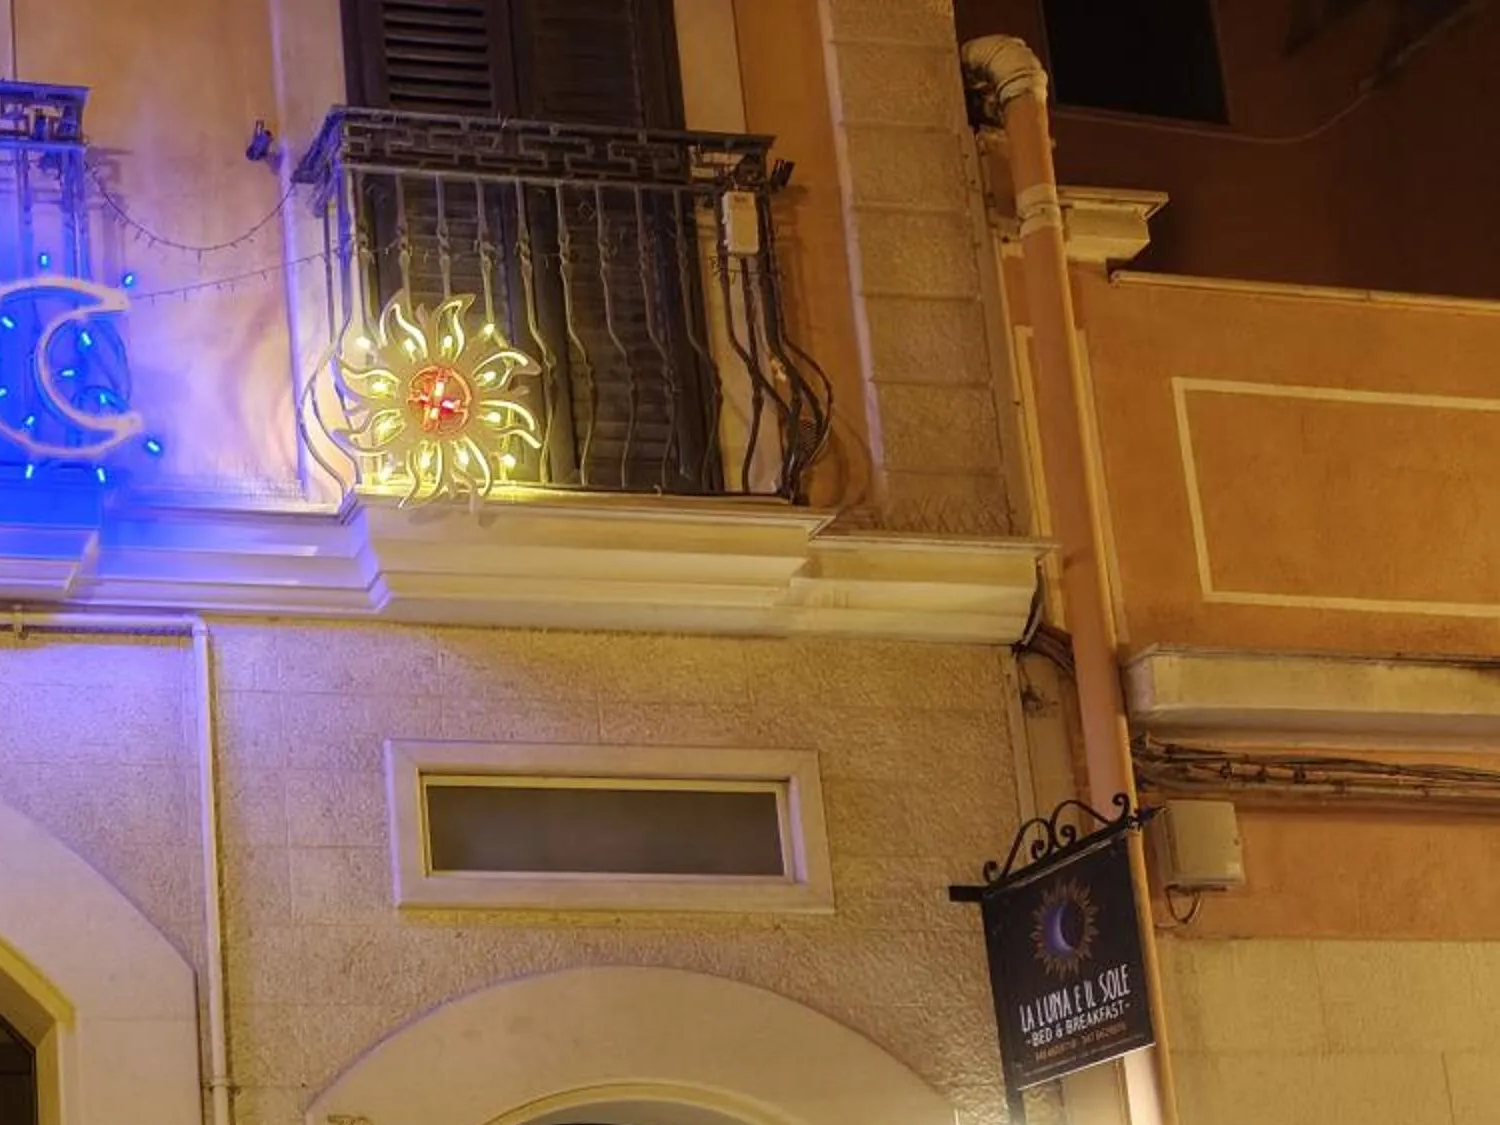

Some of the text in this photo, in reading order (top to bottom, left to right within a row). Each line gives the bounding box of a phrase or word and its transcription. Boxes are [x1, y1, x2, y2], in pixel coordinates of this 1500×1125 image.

[1019, 1003, 1036, 1033] LA
[1035, 986, 1073, 1027] LUNA
[1073, 984, 1083, 1013] E
[1097, 963, 1131, 1003] SOLE
